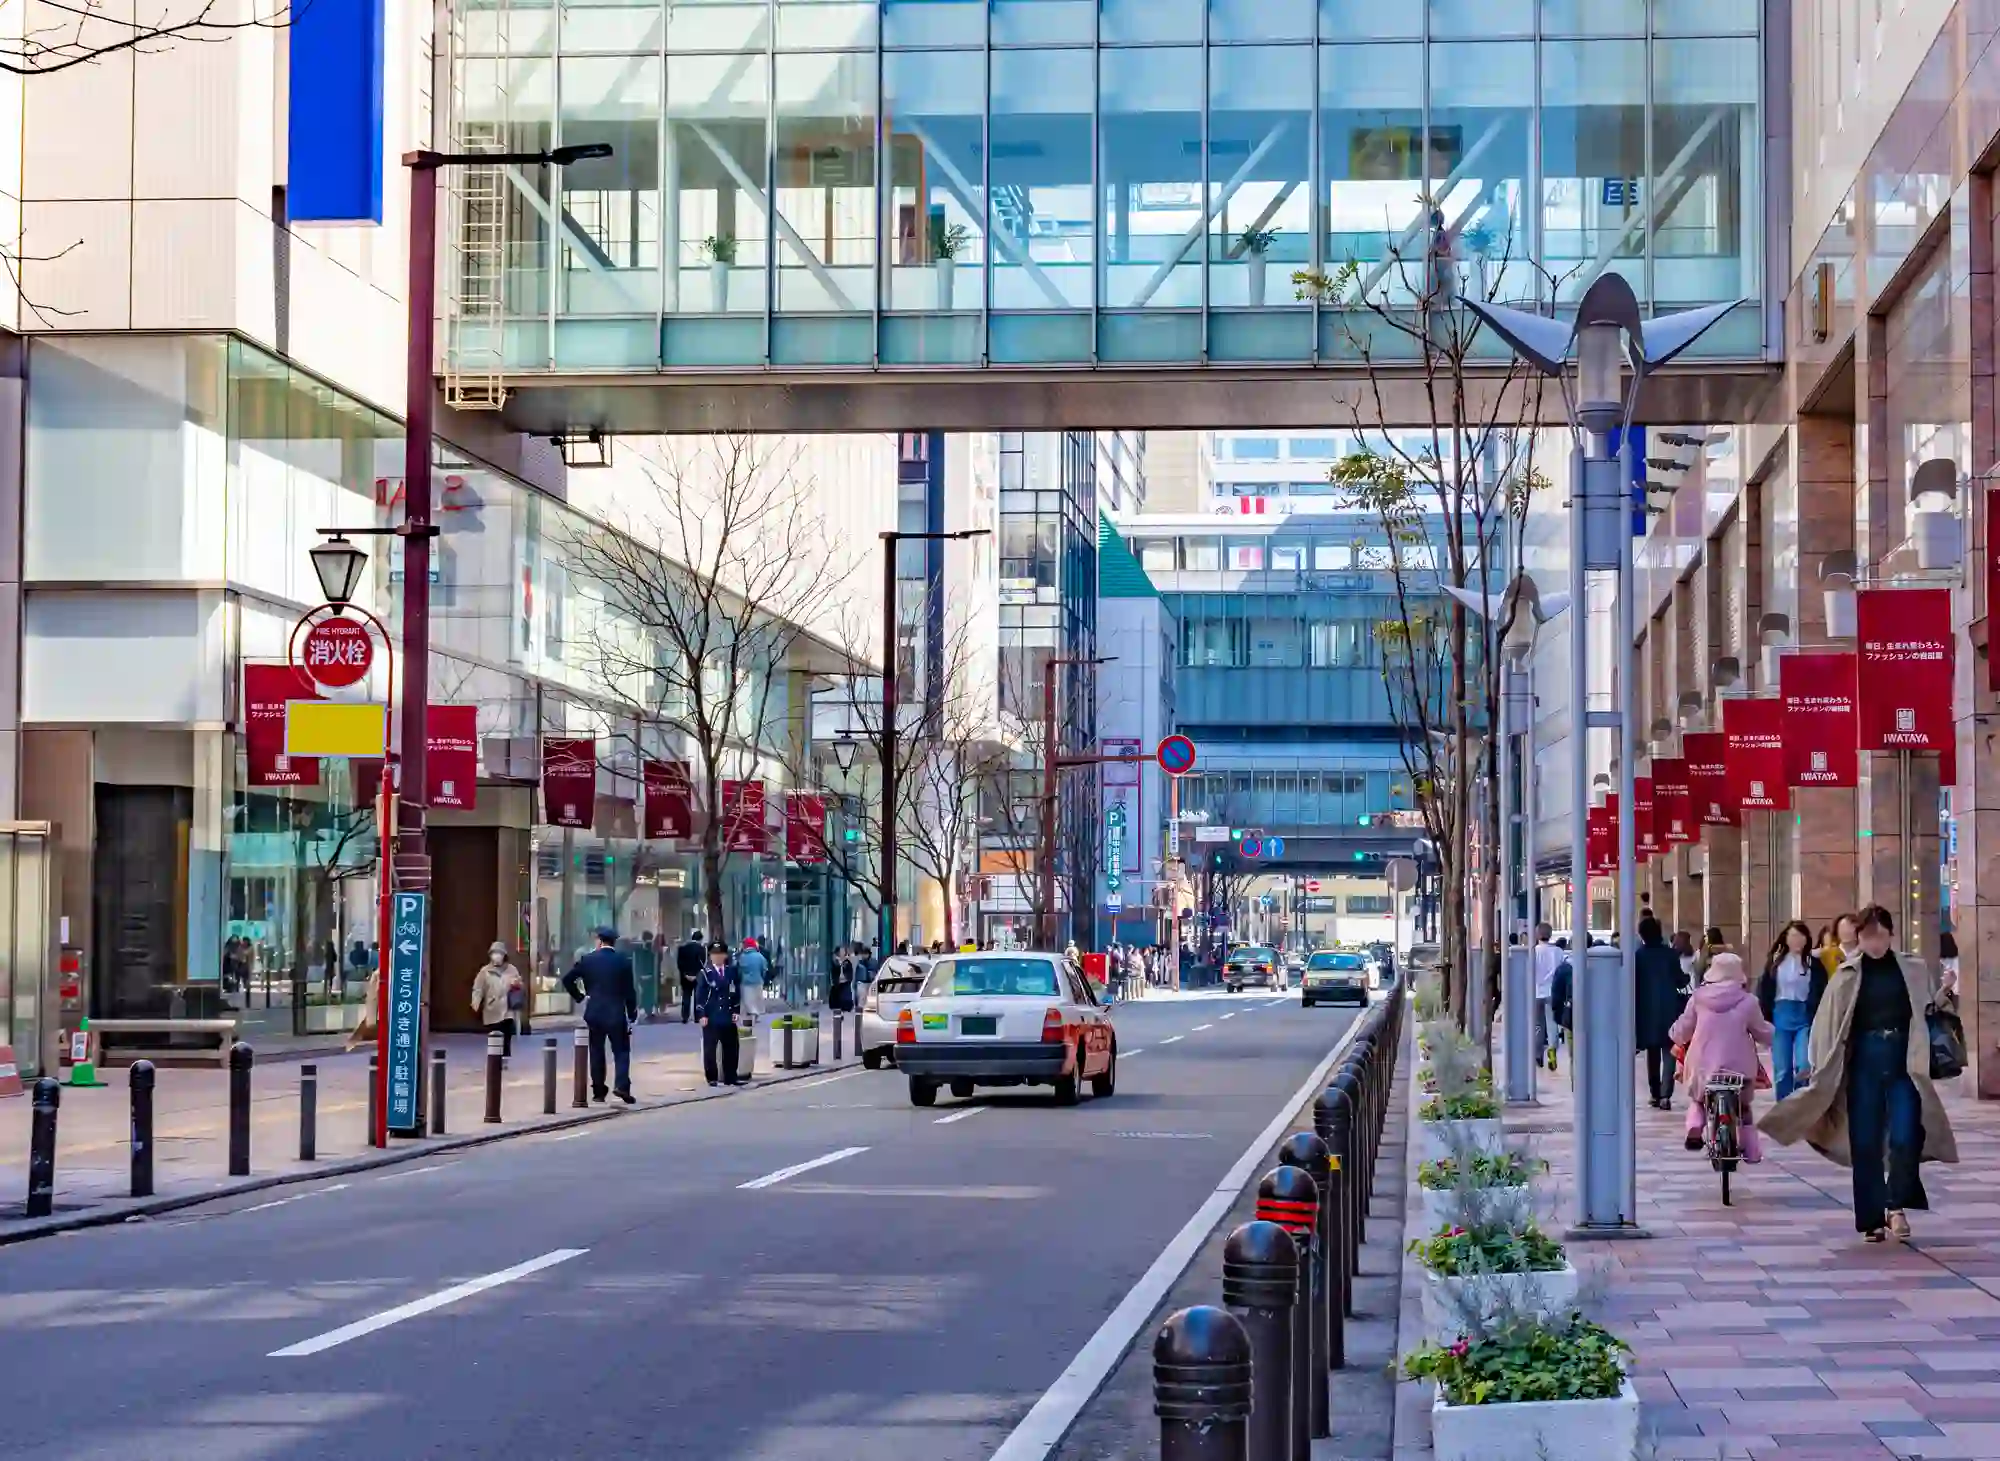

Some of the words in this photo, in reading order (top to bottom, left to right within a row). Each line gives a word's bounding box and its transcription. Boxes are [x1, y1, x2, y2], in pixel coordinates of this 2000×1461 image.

[309, 640, 366, 665] 消火栓
[1884, 734, 1929, 743] IWATAYA
[402, 898, 417, 917] P
